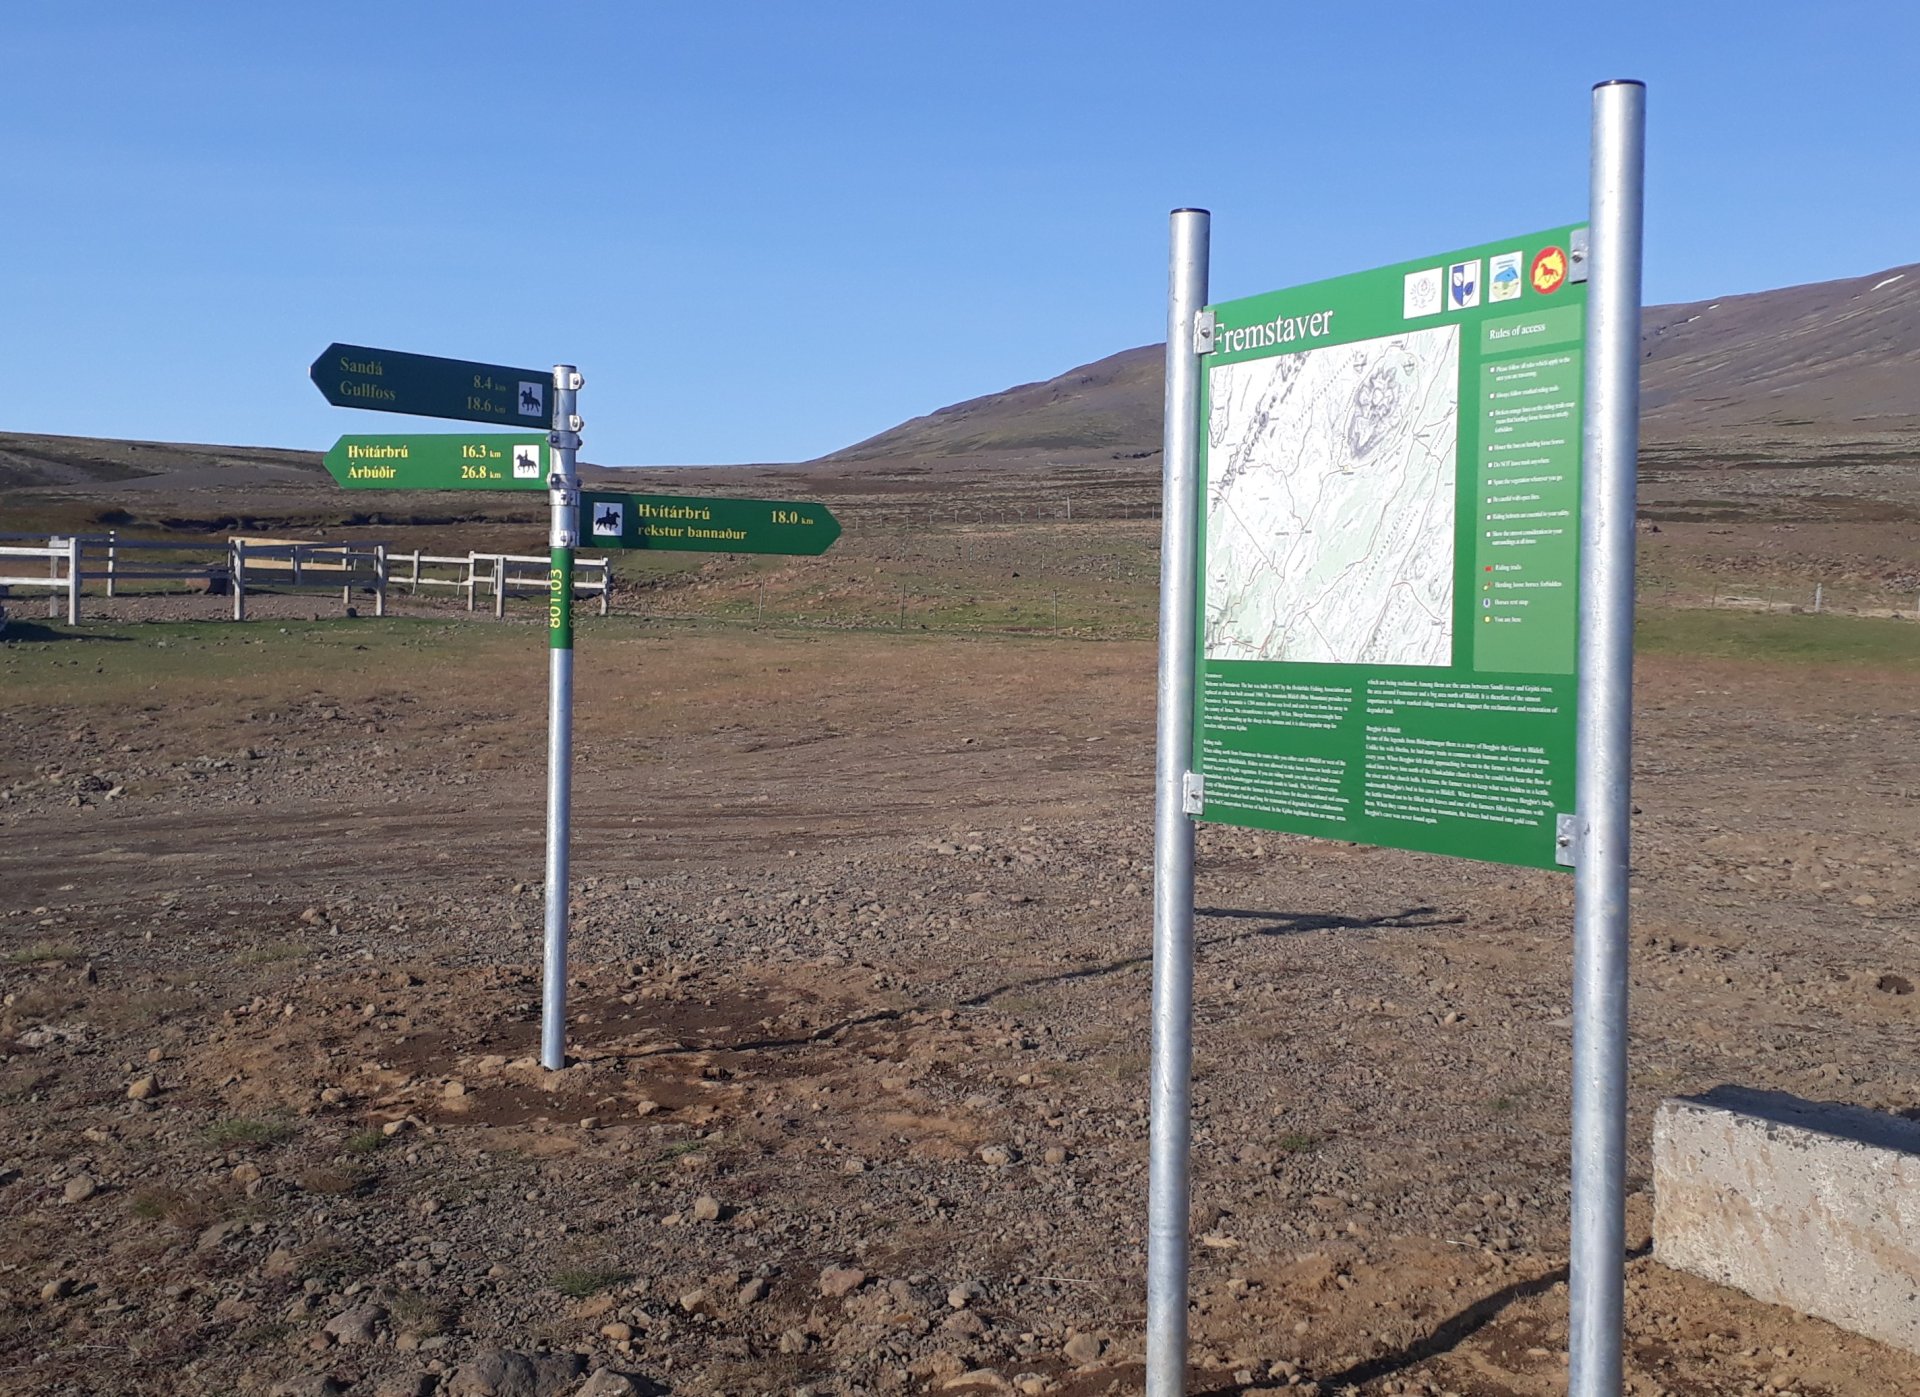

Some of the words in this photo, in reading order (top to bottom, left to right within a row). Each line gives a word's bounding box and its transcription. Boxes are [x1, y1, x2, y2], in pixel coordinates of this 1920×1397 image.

[1210, 310, 1333, 356] Fremstaver
[1489, 327, 1511, 340] Rules
[1511, 325, 1522, 336] of
[1522, 324, 1546, 334] access
[340, 357, 384, 377] Sandá
[340, 380, 397, 401] Gullfoss
[473, 375, 492, 390] 8.4
[466, 396, 492, 413] 18.6
[347, 444, 409, 458] Hvítárbrú
[461, 445, 487, 458] 16.3
[489, 449, 501, 458] km
[347, 461, 397, 479] Árbúðir
[461, 466, 487, 479] 26.8
[489, 471, 501, 479] km
[638, 503, 711, 520] Hvítárbrú
[770, 510, 798, 524] 18.0
[801, 516, 814, 525] km
[638, 525, 684, 537] rekstur
[687, 526, 748, 540] bannaður
[550, 569, 562, 628] 801.03
